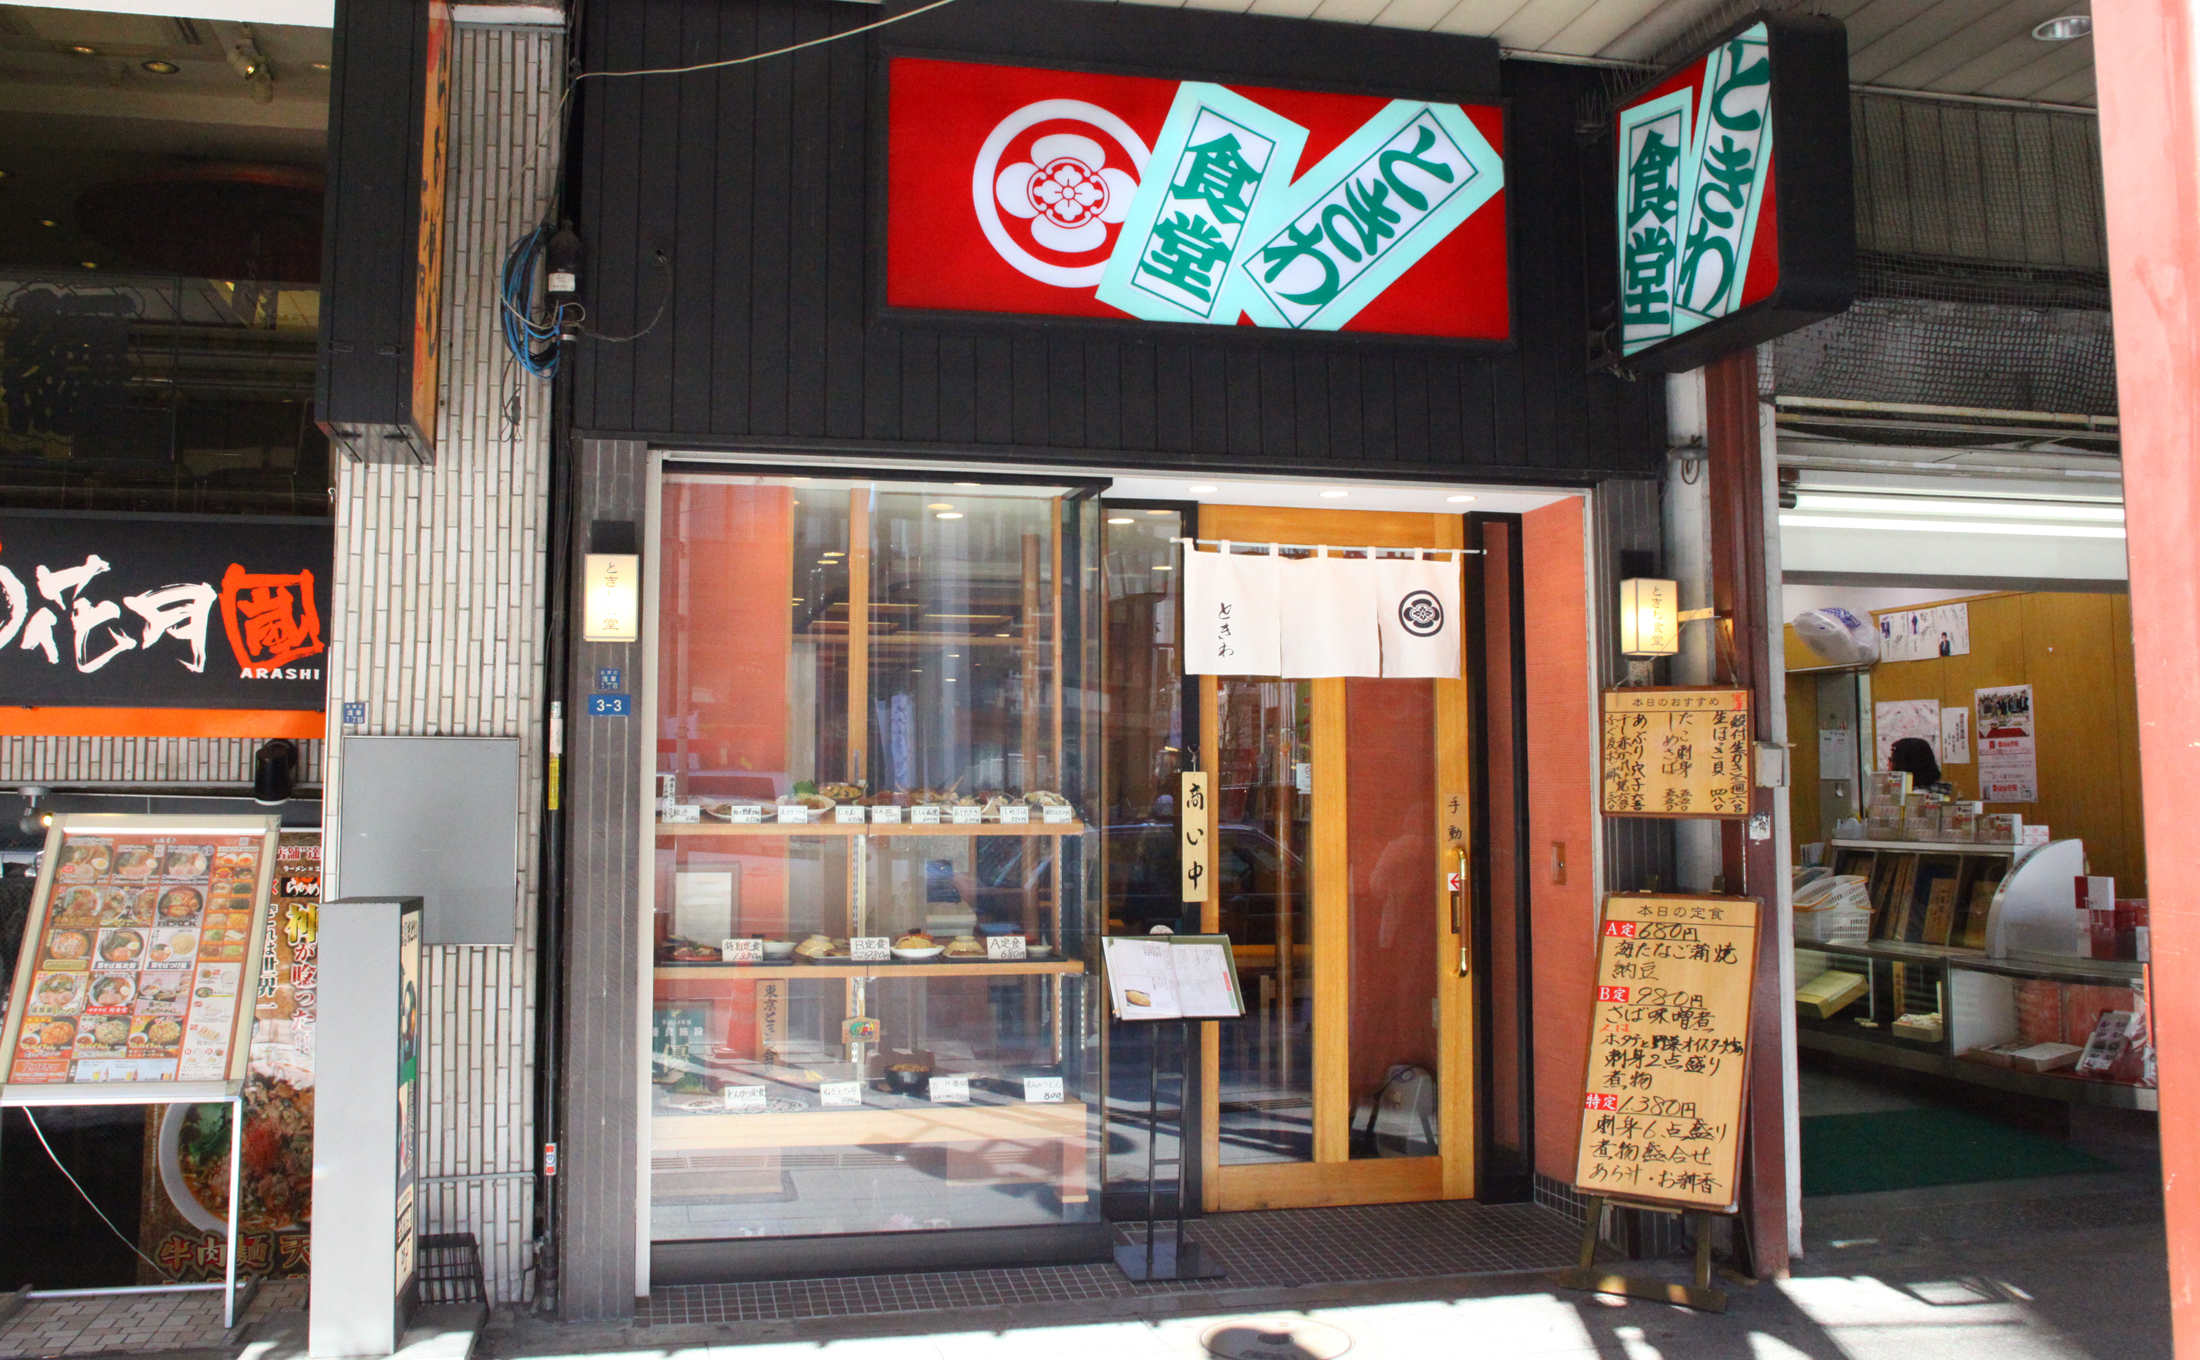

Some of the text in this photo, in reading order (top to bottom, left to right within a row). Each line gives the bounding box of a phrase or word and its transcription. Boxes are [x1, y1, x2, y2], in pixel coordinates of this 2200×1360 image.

[1681, 41, 1770, 314] ときわ
[1140, 132, 1260, 303] 食堂
[1263, 124, 1456, 307] ときわ
[1623, 129, 1682, 325] 食堂
[602, 561, 620, 631] とき堂
[1651, 586, 1664, 647] ときわ食堂
[1218, 602, 1234, 658] ときわ
[240, 667, 320, 680] ARASHI
[596, 699, 623, 713] 3-3
[1633, 697, 1720, 708] 本日のおすすめ
[1662, 712, 1678, 776] しめさば
[1447, 796, 1462, 842] 手動
[1186, 783, 1204, 890] 商い中
[1637, 905, 1724, 921] 本日の定食
[157, 920, 197, 928] BLACK
[1638, 922, 1698, 941] 680円
[724, 940, 762, 951] 特別定食
[855, 938, 888, 950] B定食
[990, 937, 1023, 951] A定食
[1001, 949, 1026, 960] 680円
[1612, 961, 1659, 981] 納豆
[1636, 987, 1703, 1008] 980円
[1606, 1005, 1716, 1033] さば味噌煮
[1603, 1070, 1654, 1090] 煮物
[1586, 1093, 1617, 1110] 特定
